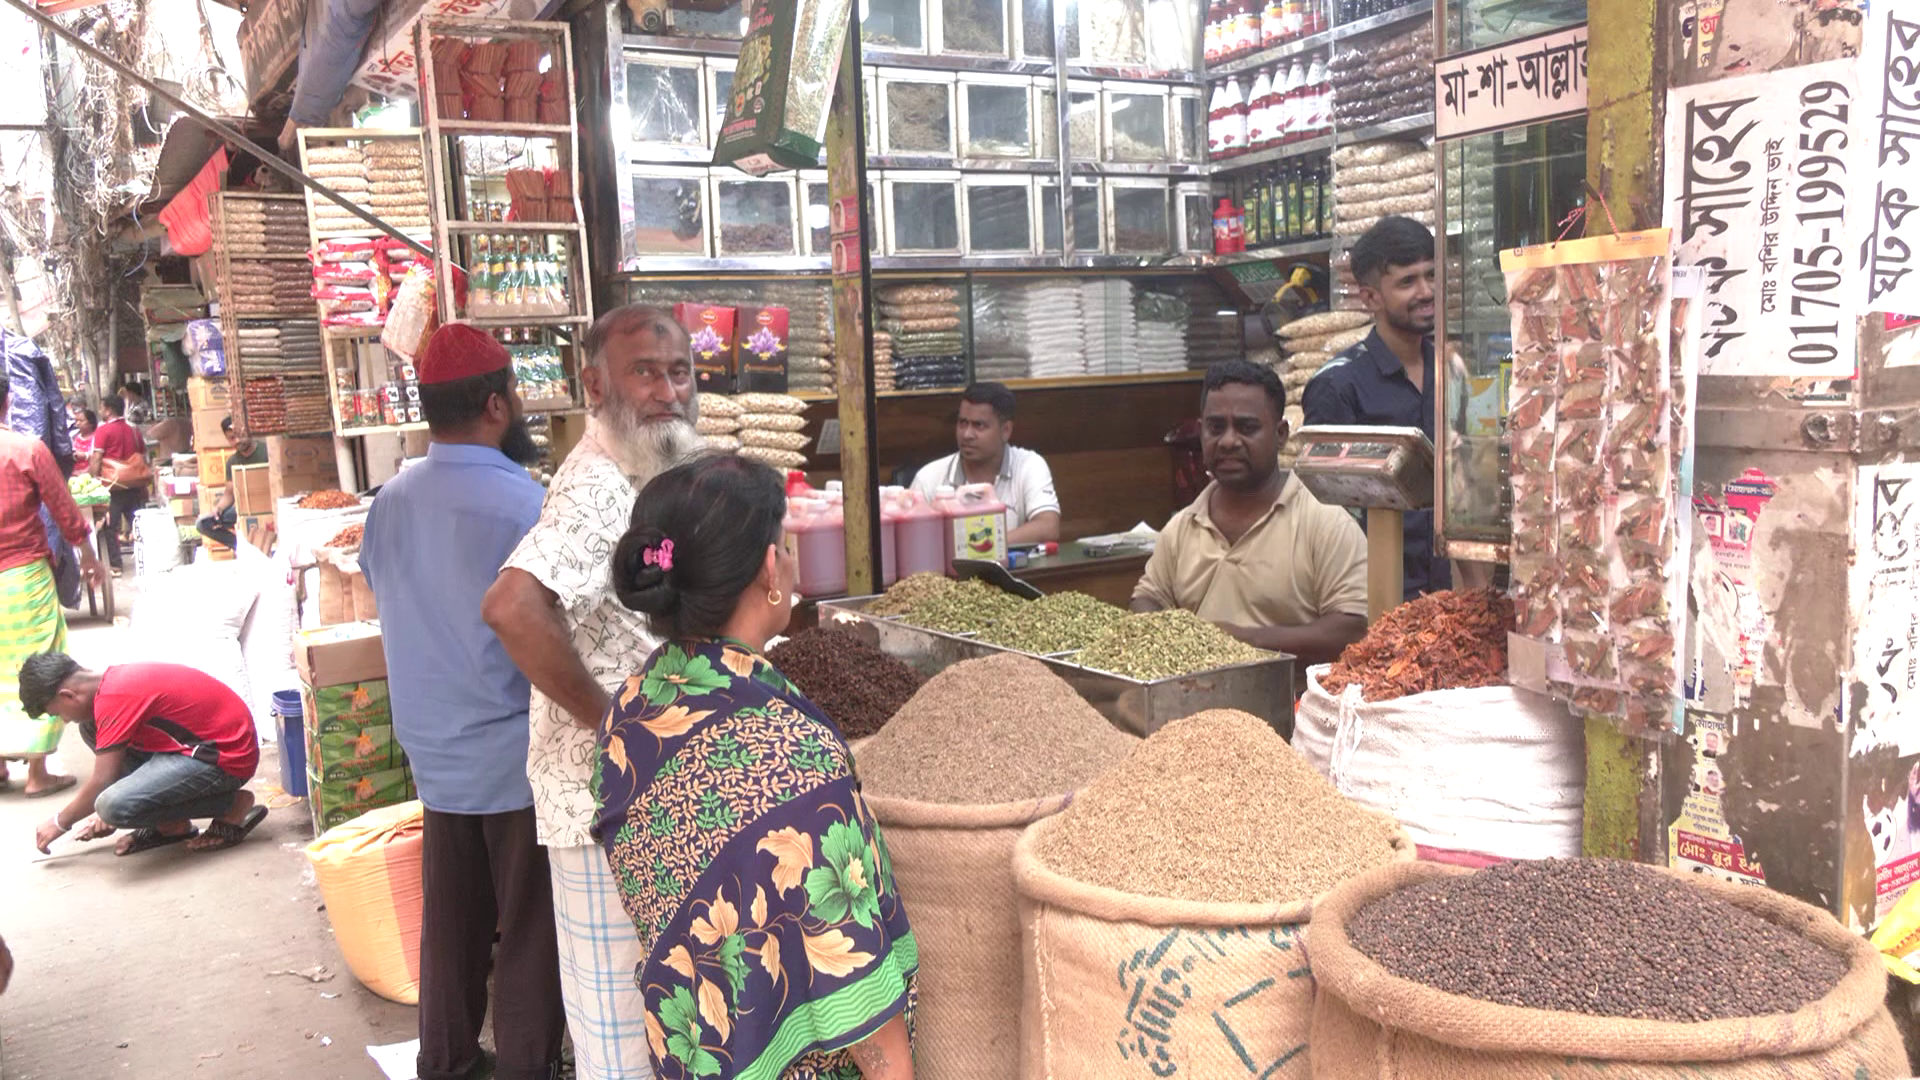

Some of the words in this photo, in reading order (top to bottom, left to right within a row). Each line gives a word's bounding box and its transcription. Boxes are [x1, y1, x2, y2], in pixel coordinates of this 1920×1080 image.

[1674, 96, 1760, 245] সাহেব
[1765, 137, 1785, 173] ভাই
[1759, 178, 1783, 227] উদ্দিন
[1787, 80, 1850, 365] 01705-199529
[1759, 232, 1780, 274] বশির
[1860, 180, 1920, 304] ঘটক
[1759, 280, 1777, 315] মোঃ
[1679, 841, 1706, 860] মোঃ
